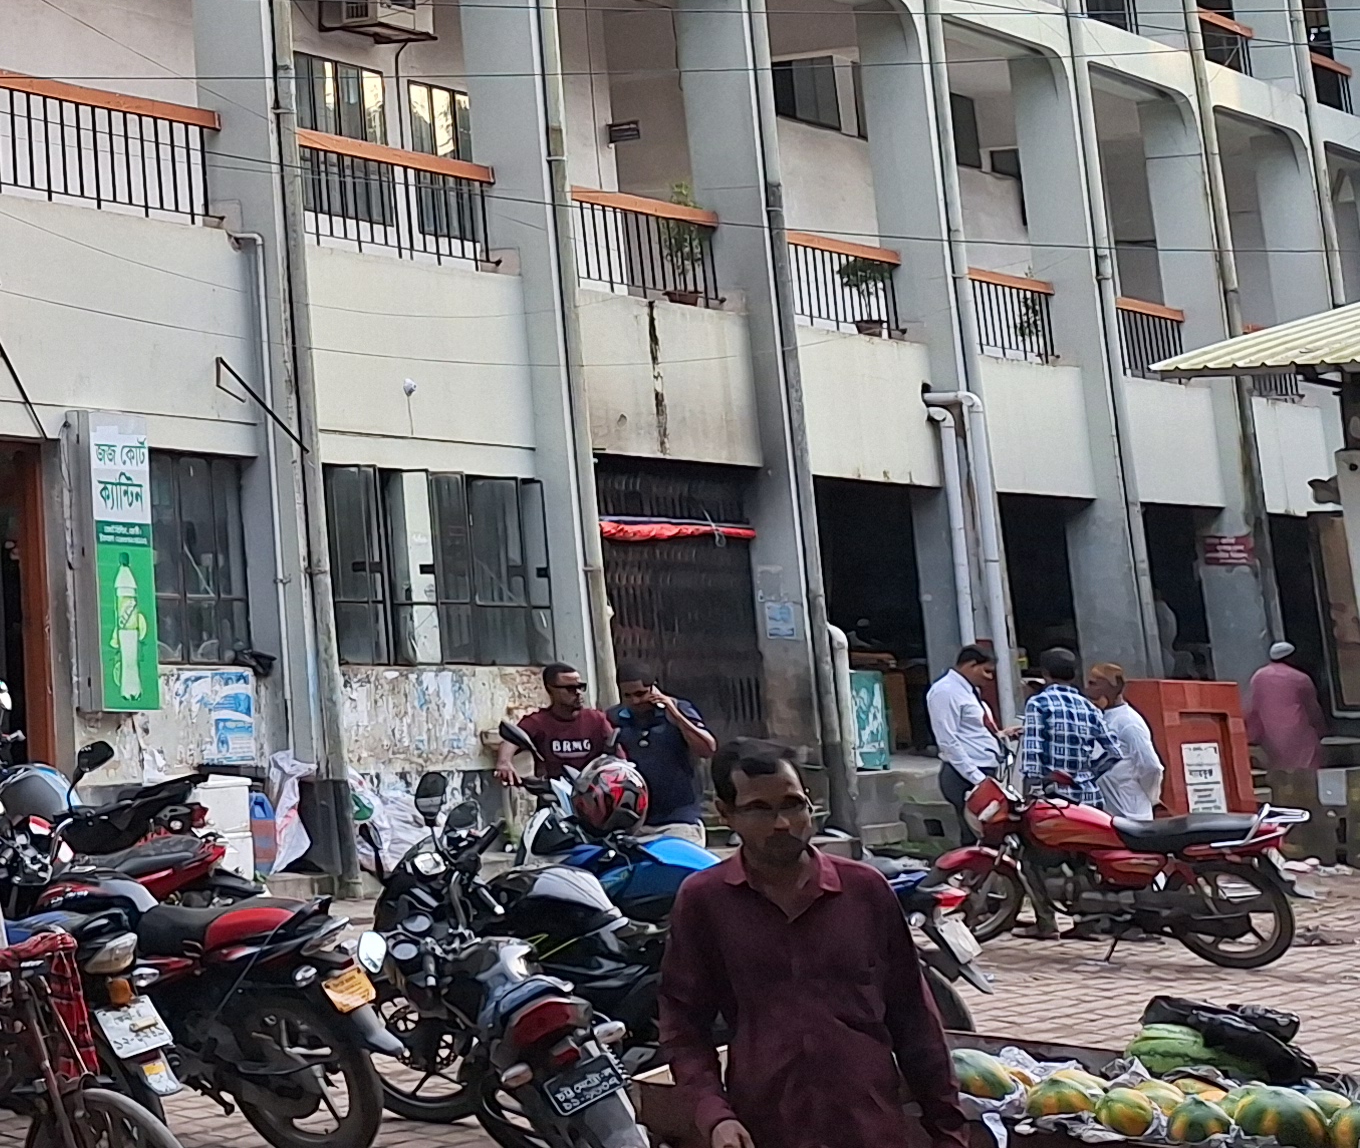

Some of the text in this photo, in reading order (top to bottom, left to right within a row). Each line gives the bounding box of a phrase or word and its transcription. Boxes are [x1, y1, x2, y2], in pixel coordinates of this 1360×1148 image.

[94, 437, 147, 467] জজ কোর্ট
[97, 471, 144, 512] ক্যান্টিন
[552, 739, 592, 752] BRMG
